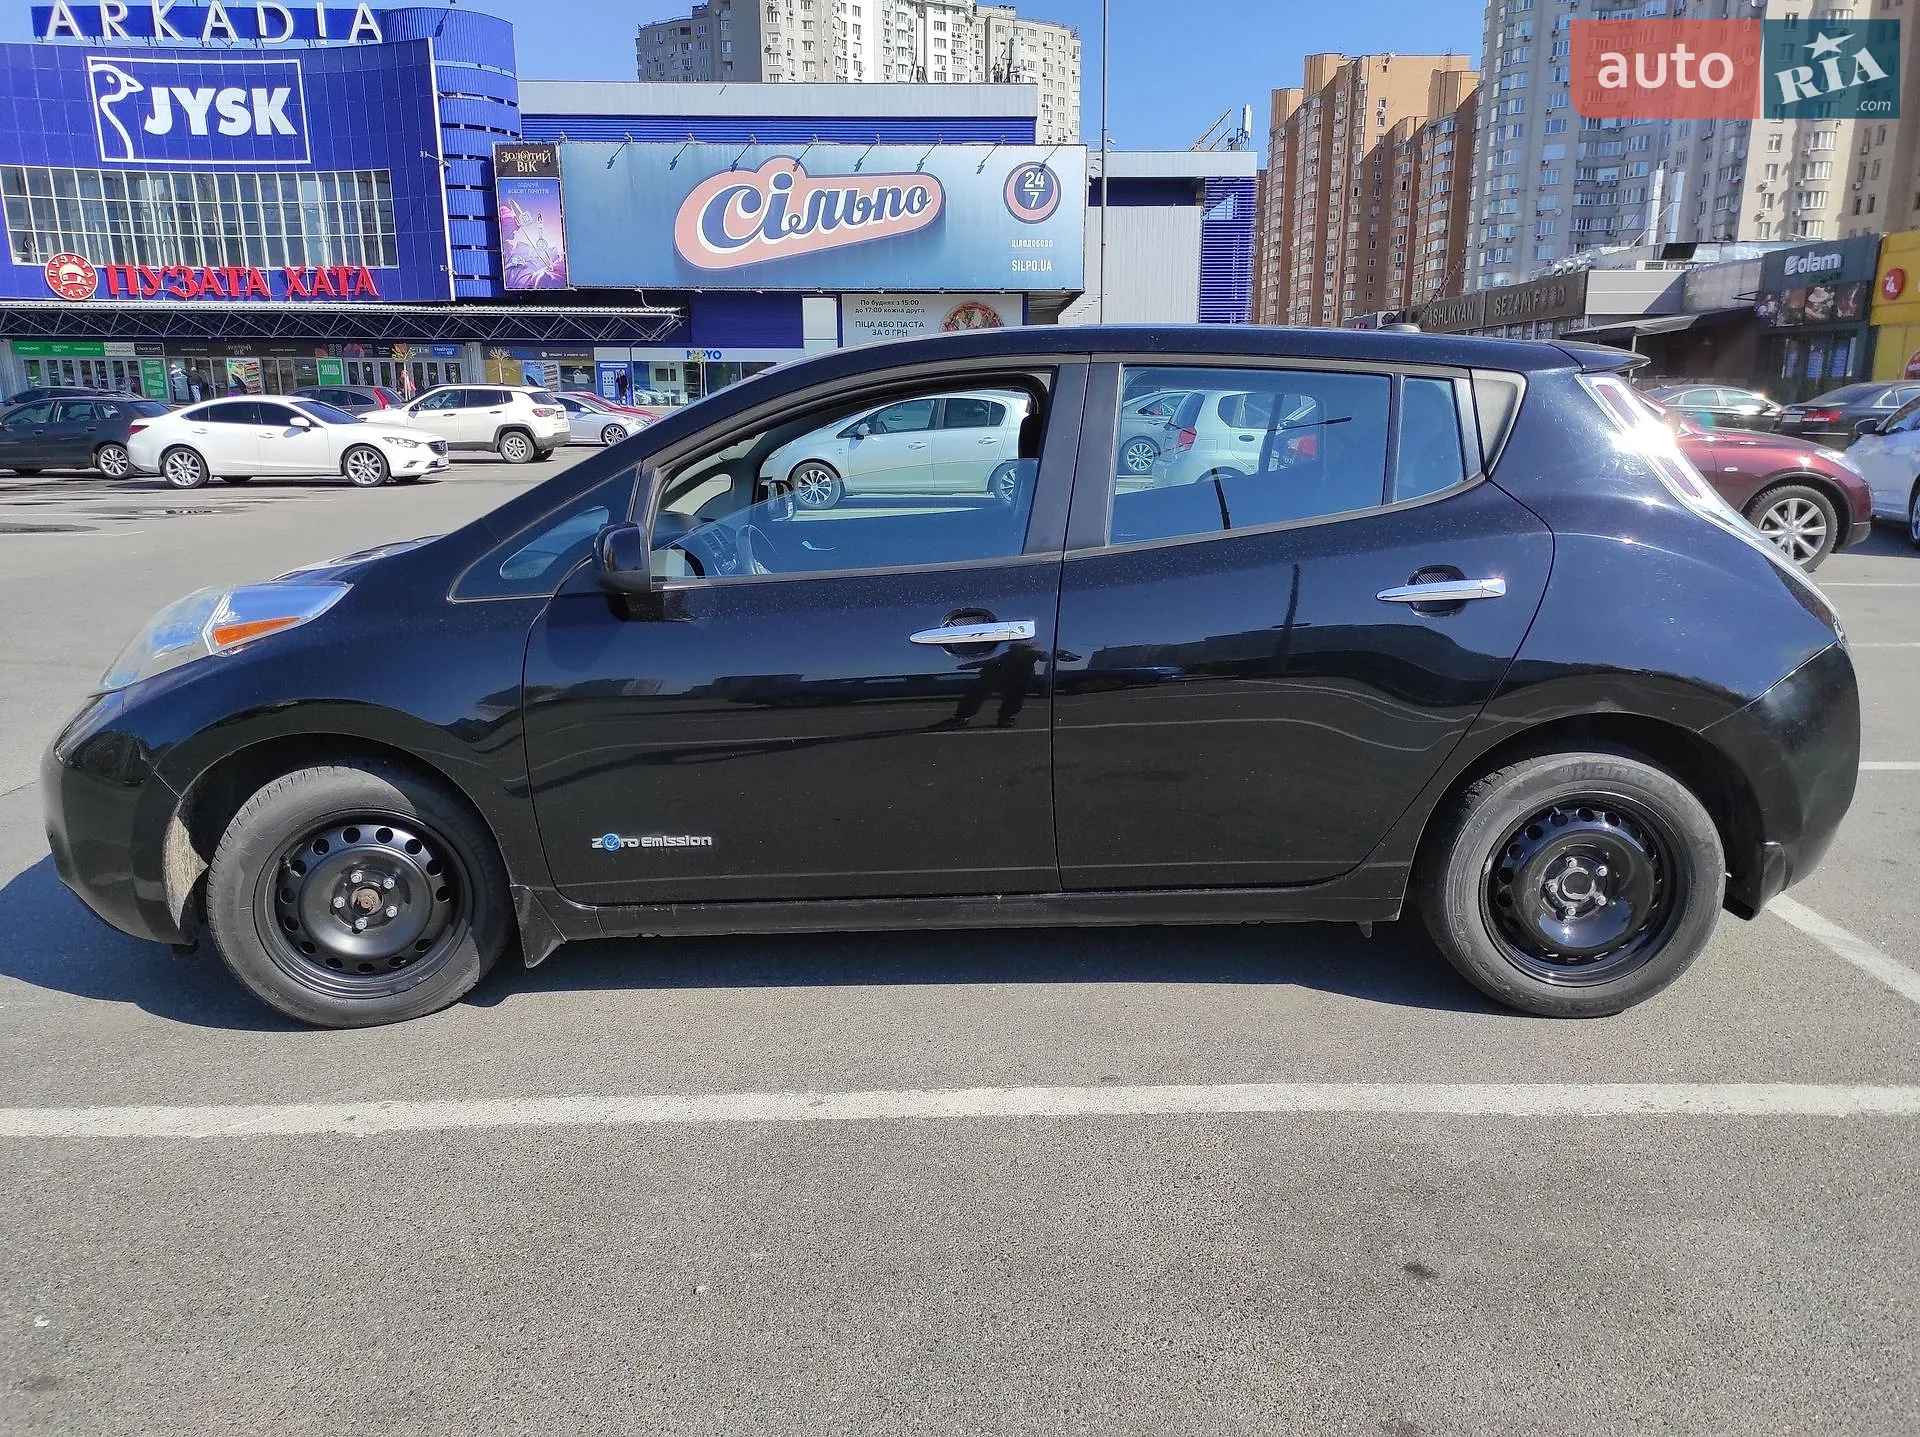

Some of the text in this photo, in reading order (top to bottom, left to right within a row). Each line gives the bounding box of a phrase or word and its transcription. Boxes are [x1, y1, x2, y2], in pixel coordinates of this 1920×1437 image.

[46, 0, 384, 44] ARKADIA
[144, 87, 298, 136] JYSK
[1024, 171, 1045, 188] 24
[1029, 191, 1040, 208] 7
[697, 171, 933, 253] Сільпо
[1011, 260, 1053, 272] SILPO.UA
[105, 264, 381, 298] ПУЗАТА ХАТА
[1419, 301, 1474, 328] ASHLIKYAN
[892, 329, 908, 337] ГРН
[687, 350, 722, 360] MYO
